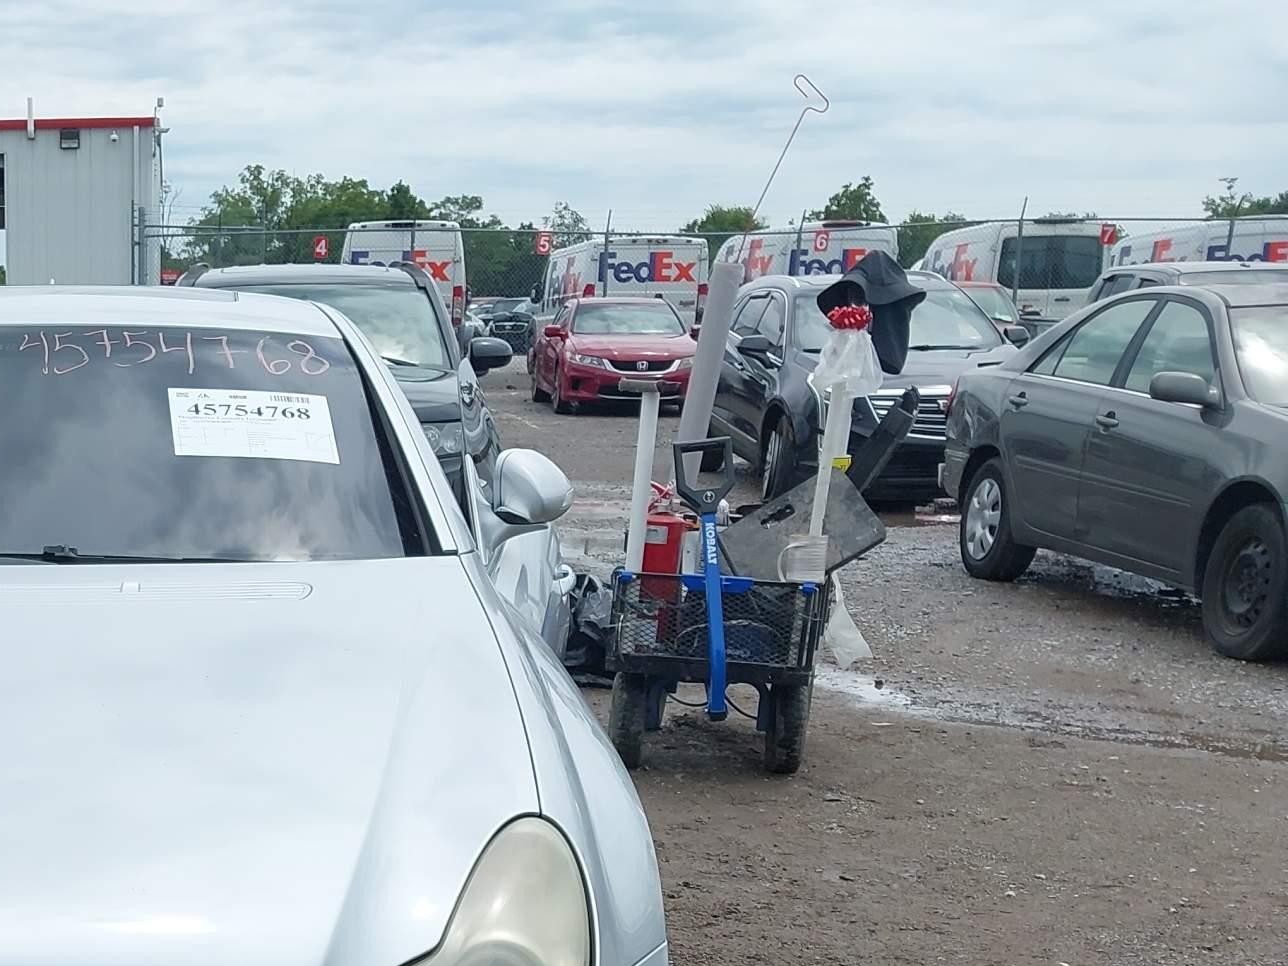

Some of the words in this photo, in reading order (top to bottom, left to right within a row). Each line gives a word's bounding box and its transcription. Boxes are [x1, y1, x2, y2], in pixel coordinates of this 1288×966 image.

[816, 234, 827, 250] 6
[1103, 227, 1115, 243] 7
[316, 239, 327, 256] 4
[538, 236, 550, 252] 5
[598, 251, 696, 283] FedEx
[20, 330, 330, 375] 45754768
[187, 403, 311, 420] 45754768
[705, 522, 717, 565] KOBALT
